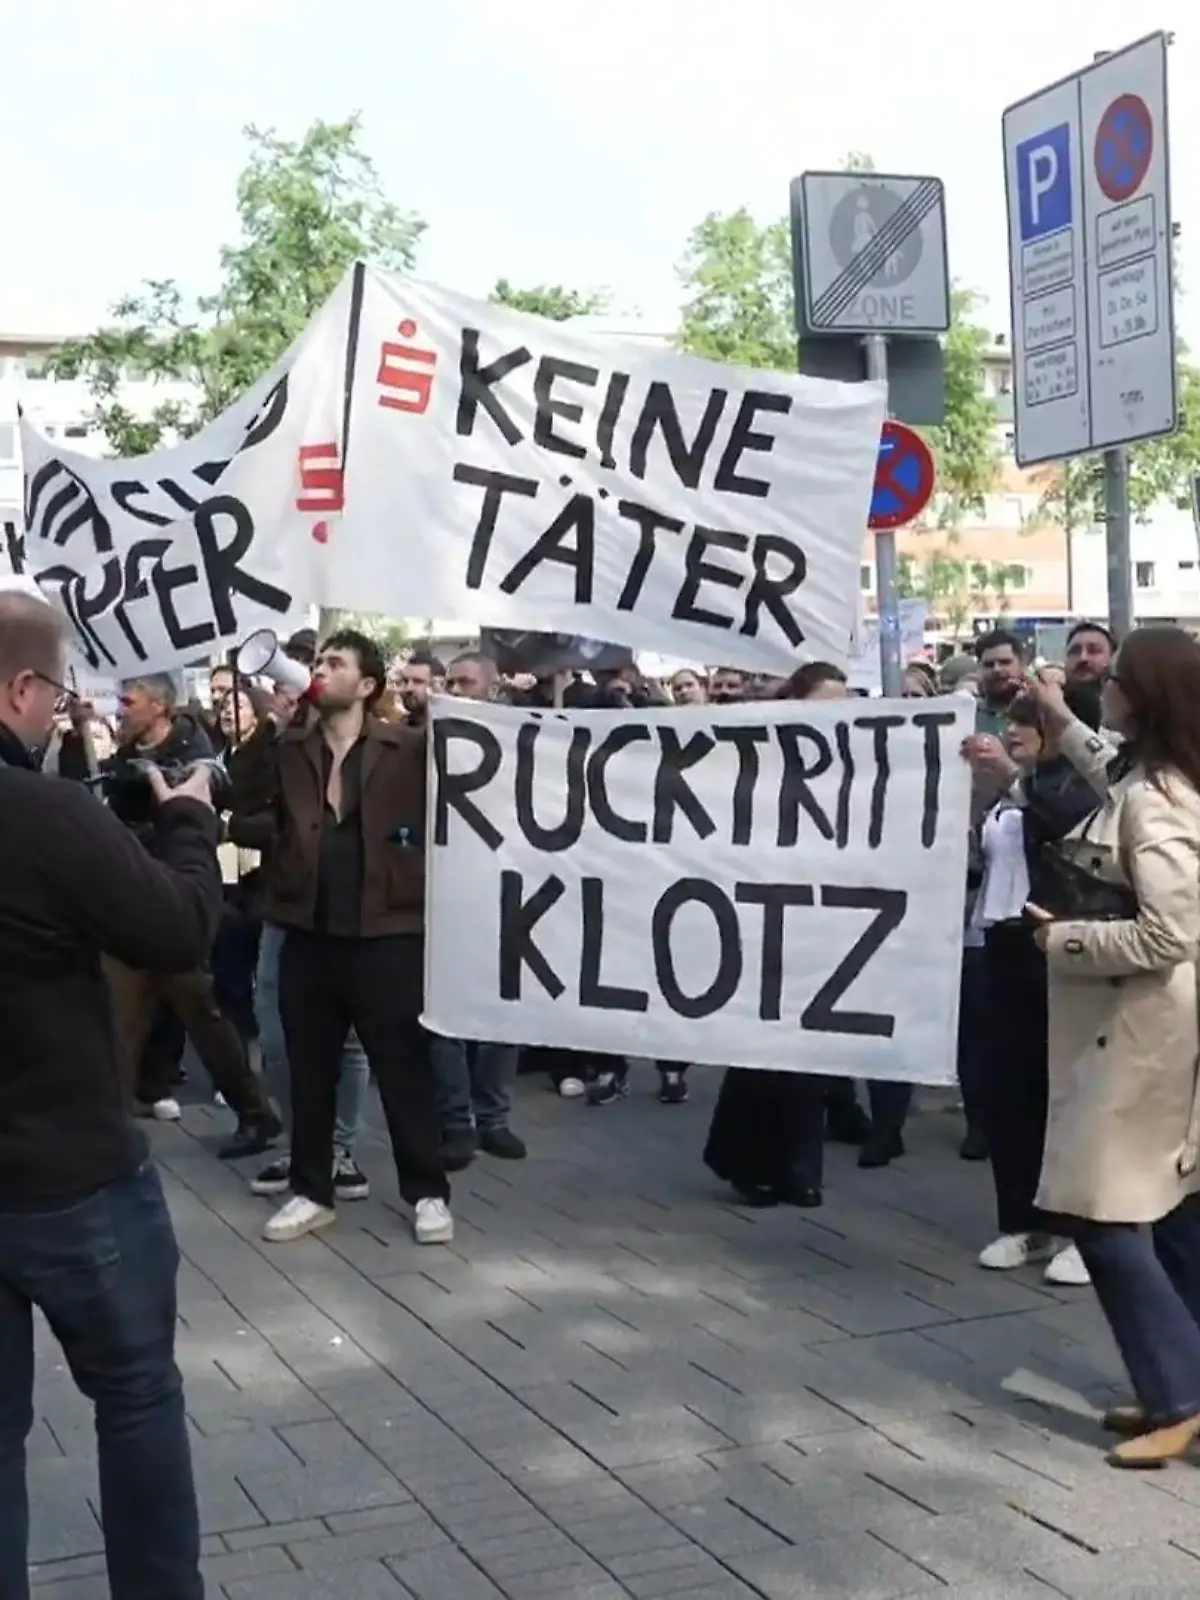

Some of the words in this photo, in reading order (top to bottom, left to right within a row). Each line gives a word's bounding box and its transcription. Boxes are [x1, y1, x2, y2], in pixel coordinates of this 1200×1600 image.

[846, 294, 916, 321] ZONE
[455, 327, 793, 498] KEINE
[452, 463, 806, 648] TÄTER
[432, 711, 957, 853] RÜCKTRITT
[500, 869, 908, 1038] KLOTZ
